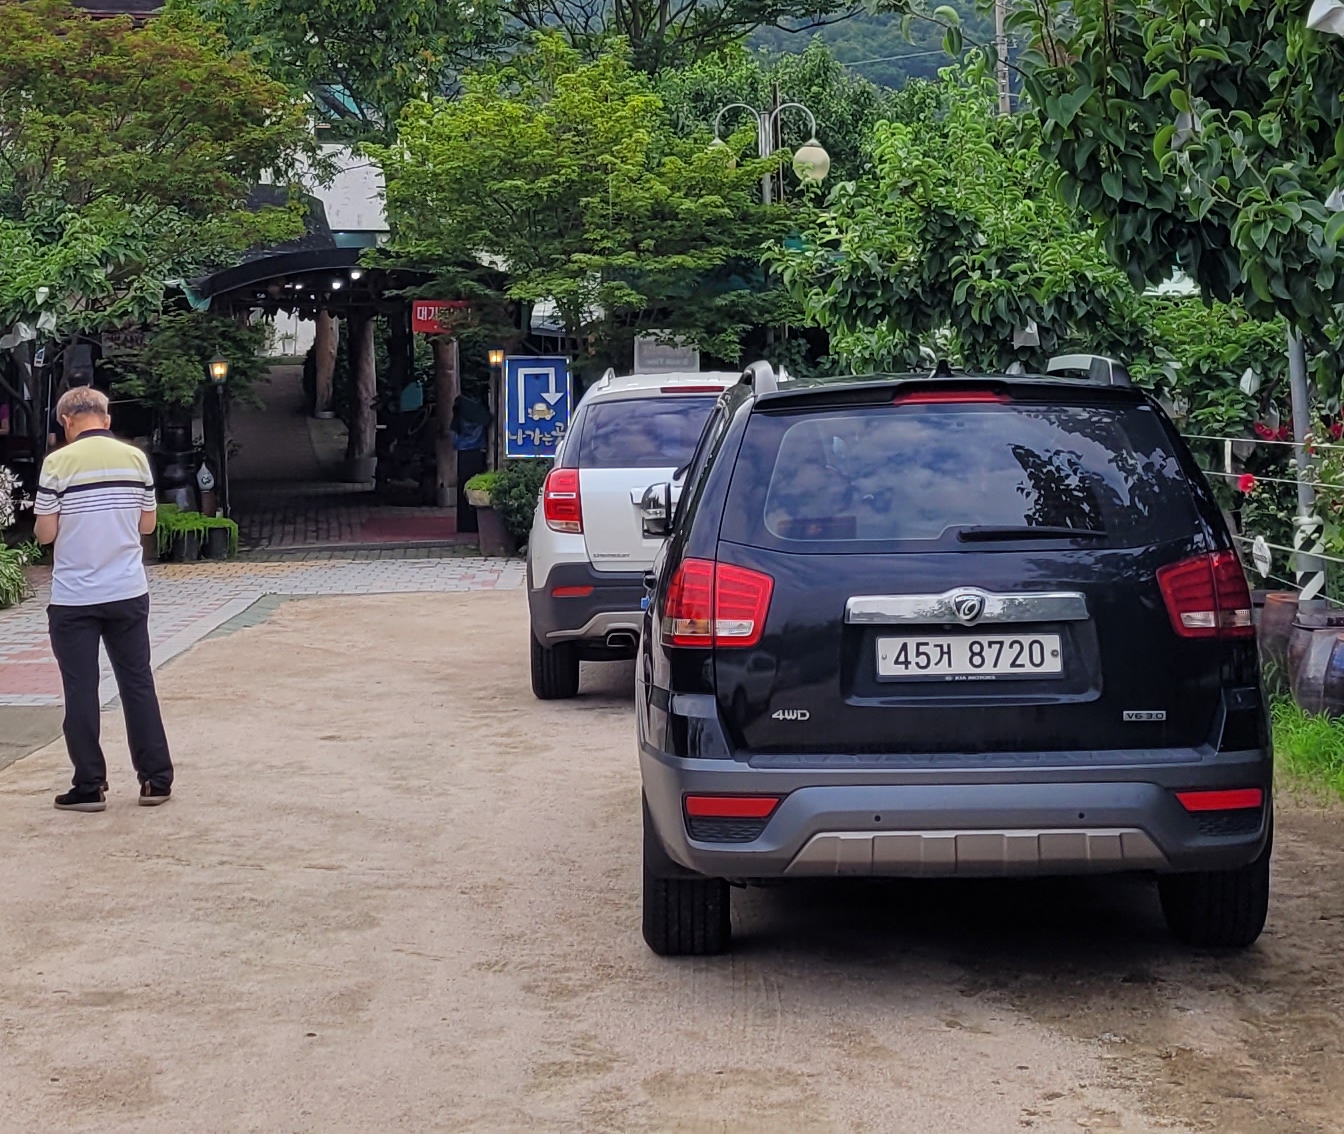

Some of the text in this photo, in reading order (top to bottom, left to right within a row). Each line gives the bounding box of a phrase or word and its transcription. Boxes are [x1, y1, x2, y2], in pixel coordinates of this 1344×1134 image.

[508, 422, 566, 446] 나가는곳
[893, 639, 1045, 670] 45거 8720
[771, 709, 810, 720] 4WD
